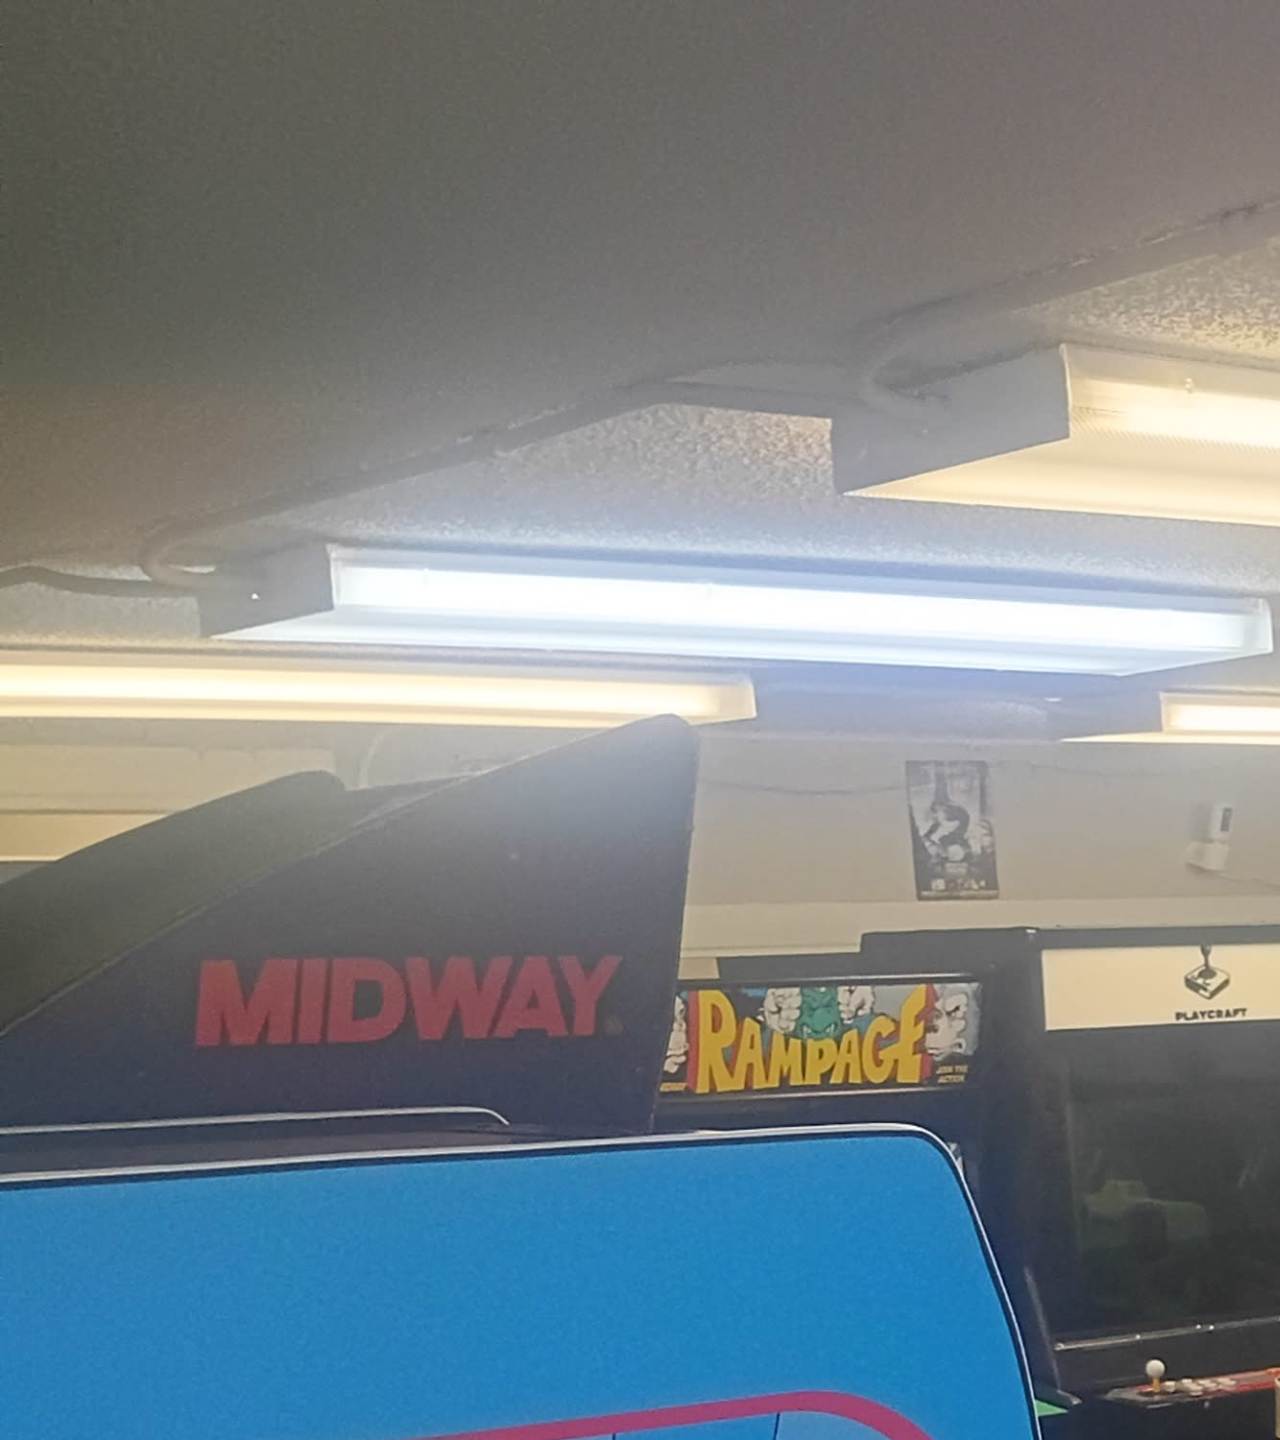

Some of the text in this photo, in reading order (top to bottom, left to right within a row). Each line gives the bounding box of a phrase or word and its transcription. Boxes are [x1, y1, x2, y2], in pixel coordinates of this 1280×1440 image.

[194, 955, 624, 1047] MIDWAY
[694, 983, 928, 1094] RAMPAGE
[1174, 1008, 1248, 1021] PLAYCRAFT
